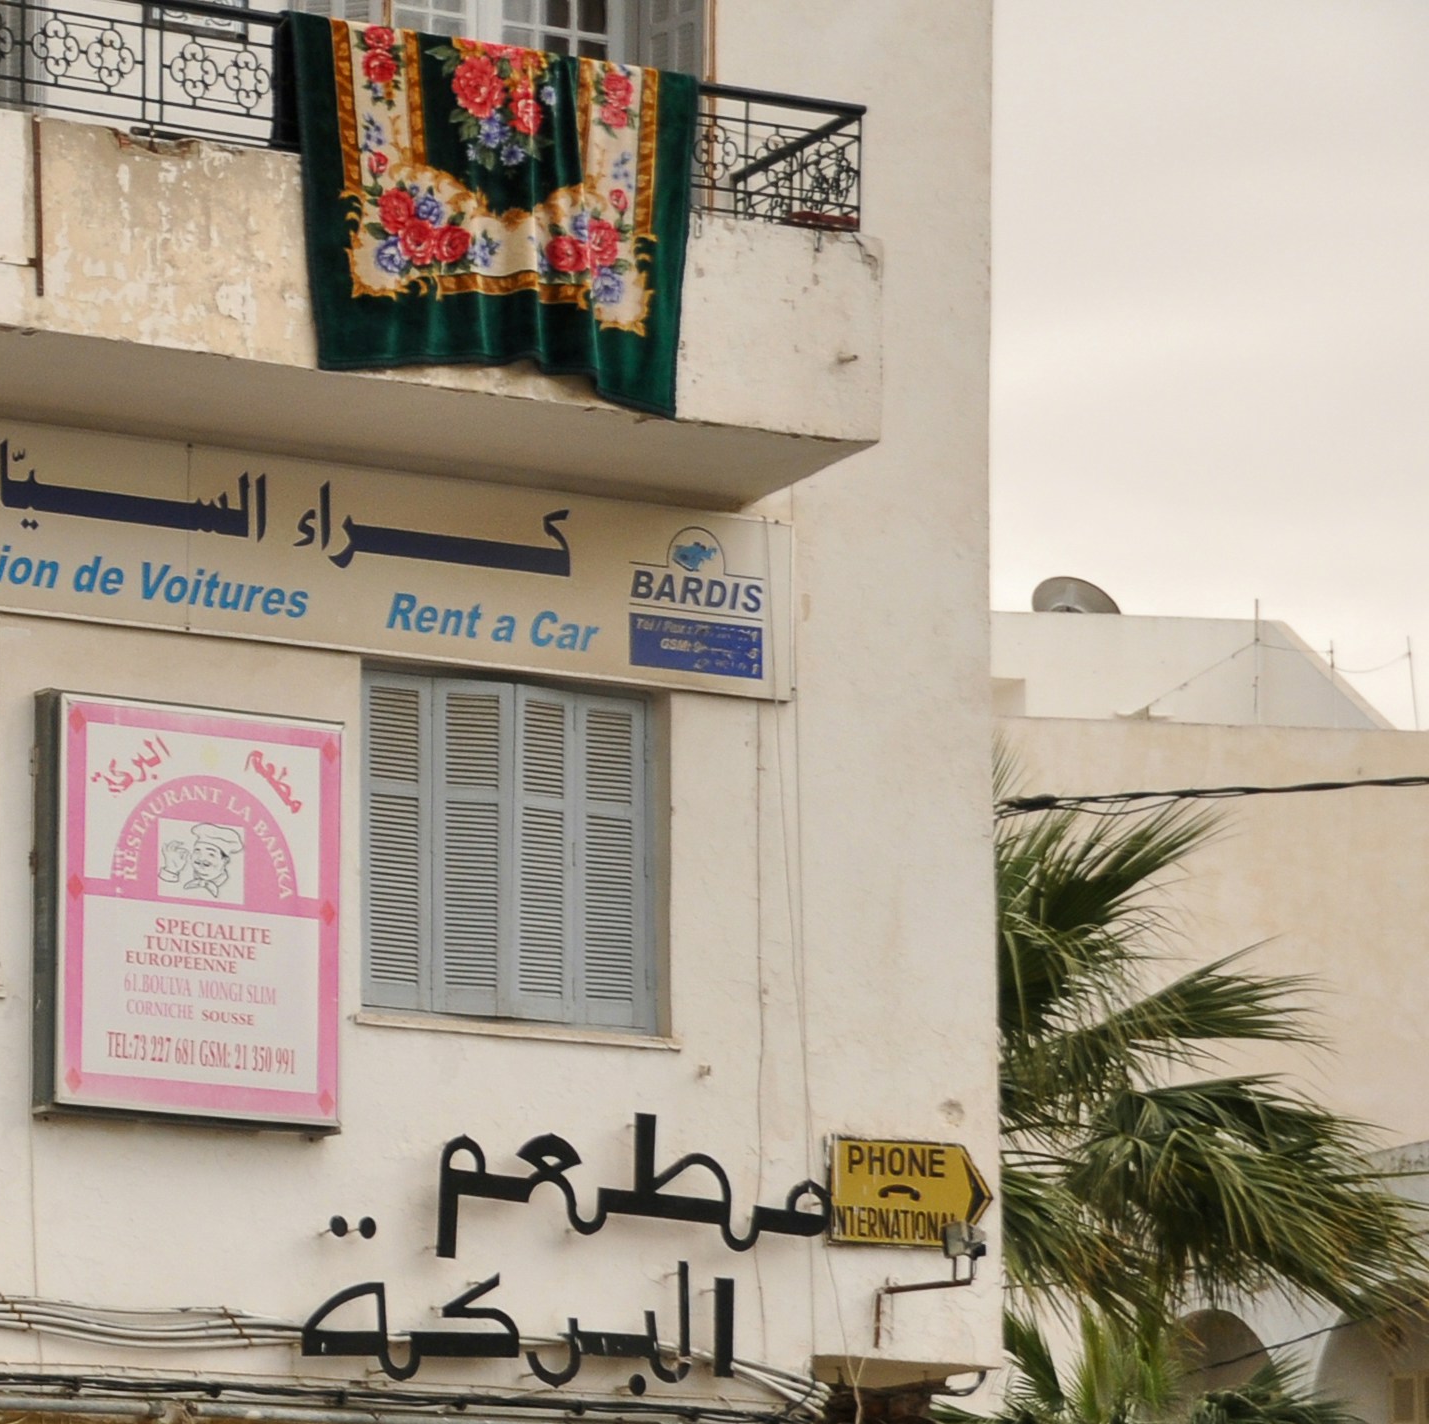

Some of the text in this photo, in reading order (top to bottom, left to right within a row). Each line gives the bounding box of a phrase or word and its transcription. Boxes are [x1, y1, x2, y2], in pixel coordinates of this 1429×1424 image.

[73, 555, 125, 595] de
[139, 561, 309, 619] Voitures
[630, 569, 763, 613] BARDIS
[386, 592, 600, 652] Rent a Car
[123, 785, 222, 880] RESTAURANT
[227, 796, 253, 822] LA
[144, 935, 257, 960] TUNISIENNE
[155, 917, 272, 945] SPECIALITE
[126, 999, 254, 1026] CORNICHE SOUSSE
[198, 980, 242, 1002] MONGI
[246, 984, 277, 1005] SLIM
[150, 1035, 171, 1062] 227
[175, 1038, 195, 1065] 681
[199, 1040, 231, 1068] GSM:
[234, 1043, 248, 1070] 21
[252, 1045, 272, 1072] 350
[276, 1048, 295, 1074] 991
[848, 1145, 946, 1178] PHONE
[436, 1112, 831, 1258] مطعم
[302, 1214, 735, 1396] البركة
